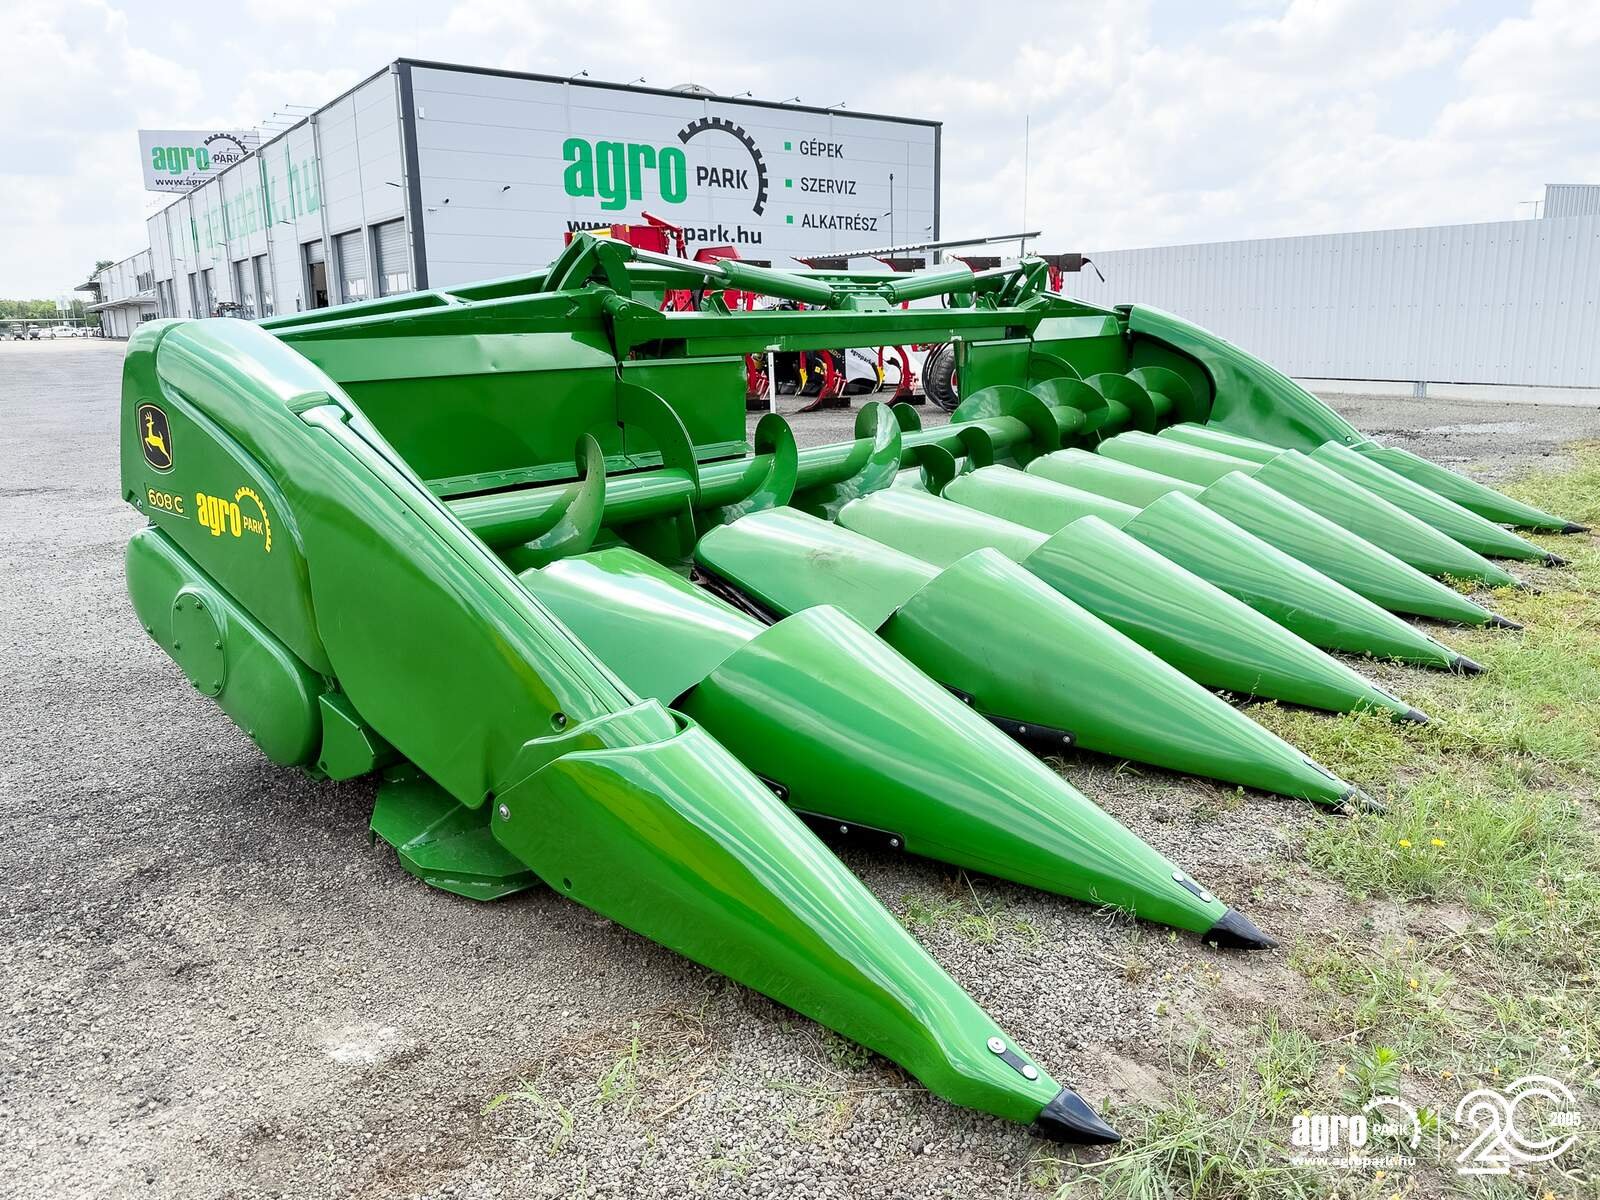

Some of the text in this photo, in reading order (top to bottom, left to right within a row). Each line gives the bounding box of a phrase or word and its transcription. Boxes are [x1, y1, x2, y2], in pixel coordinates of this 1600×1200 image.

[152, 146, 209, 174] agro
[799, 140, 844, 159] GÉPEK
[563, 137, 748, 211] agro PARK
[800, 177, 857, 195] SZERVIZ
[801, 213, 878, 231] ALKATRÉSZ
[196, 492, 264, 537] agro PARK
